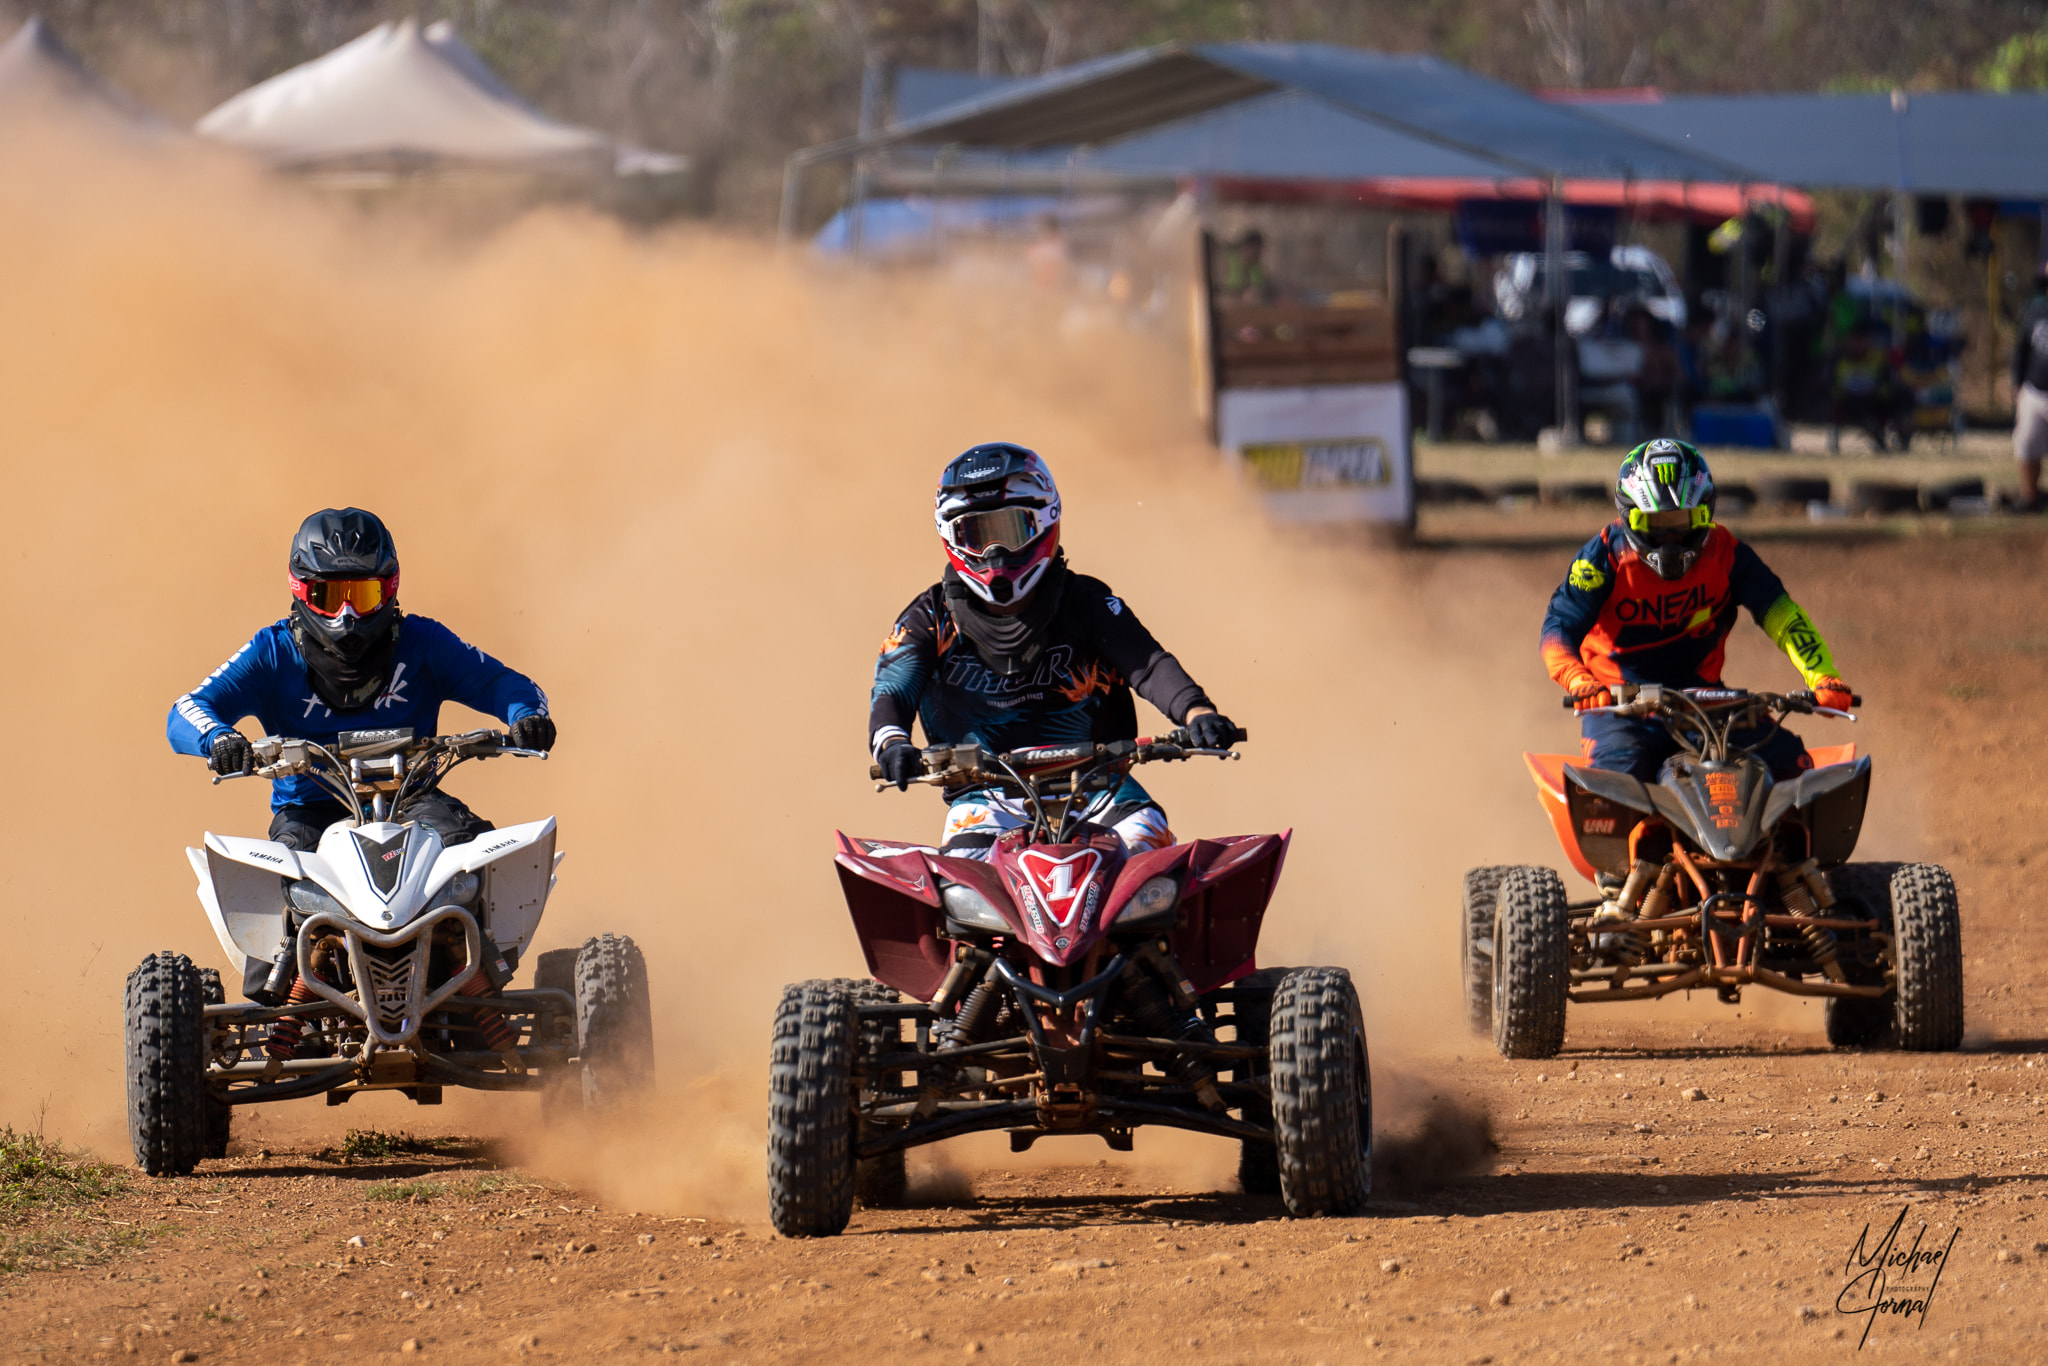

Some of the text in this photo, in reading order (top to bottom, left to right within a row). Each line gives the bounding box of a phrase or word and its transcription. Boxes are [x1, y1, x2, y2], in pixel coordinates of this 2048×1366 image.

[1639, 488, 1652, 508] THOR
[350, 729, 400, 739] flexx
[1025, 747, 1081, 761] flexx
[482, 838, 519, 854] YAMAHA
[248, 850, 284, 865] YAMAHA
[1045, 864, 1077, 902] 1
